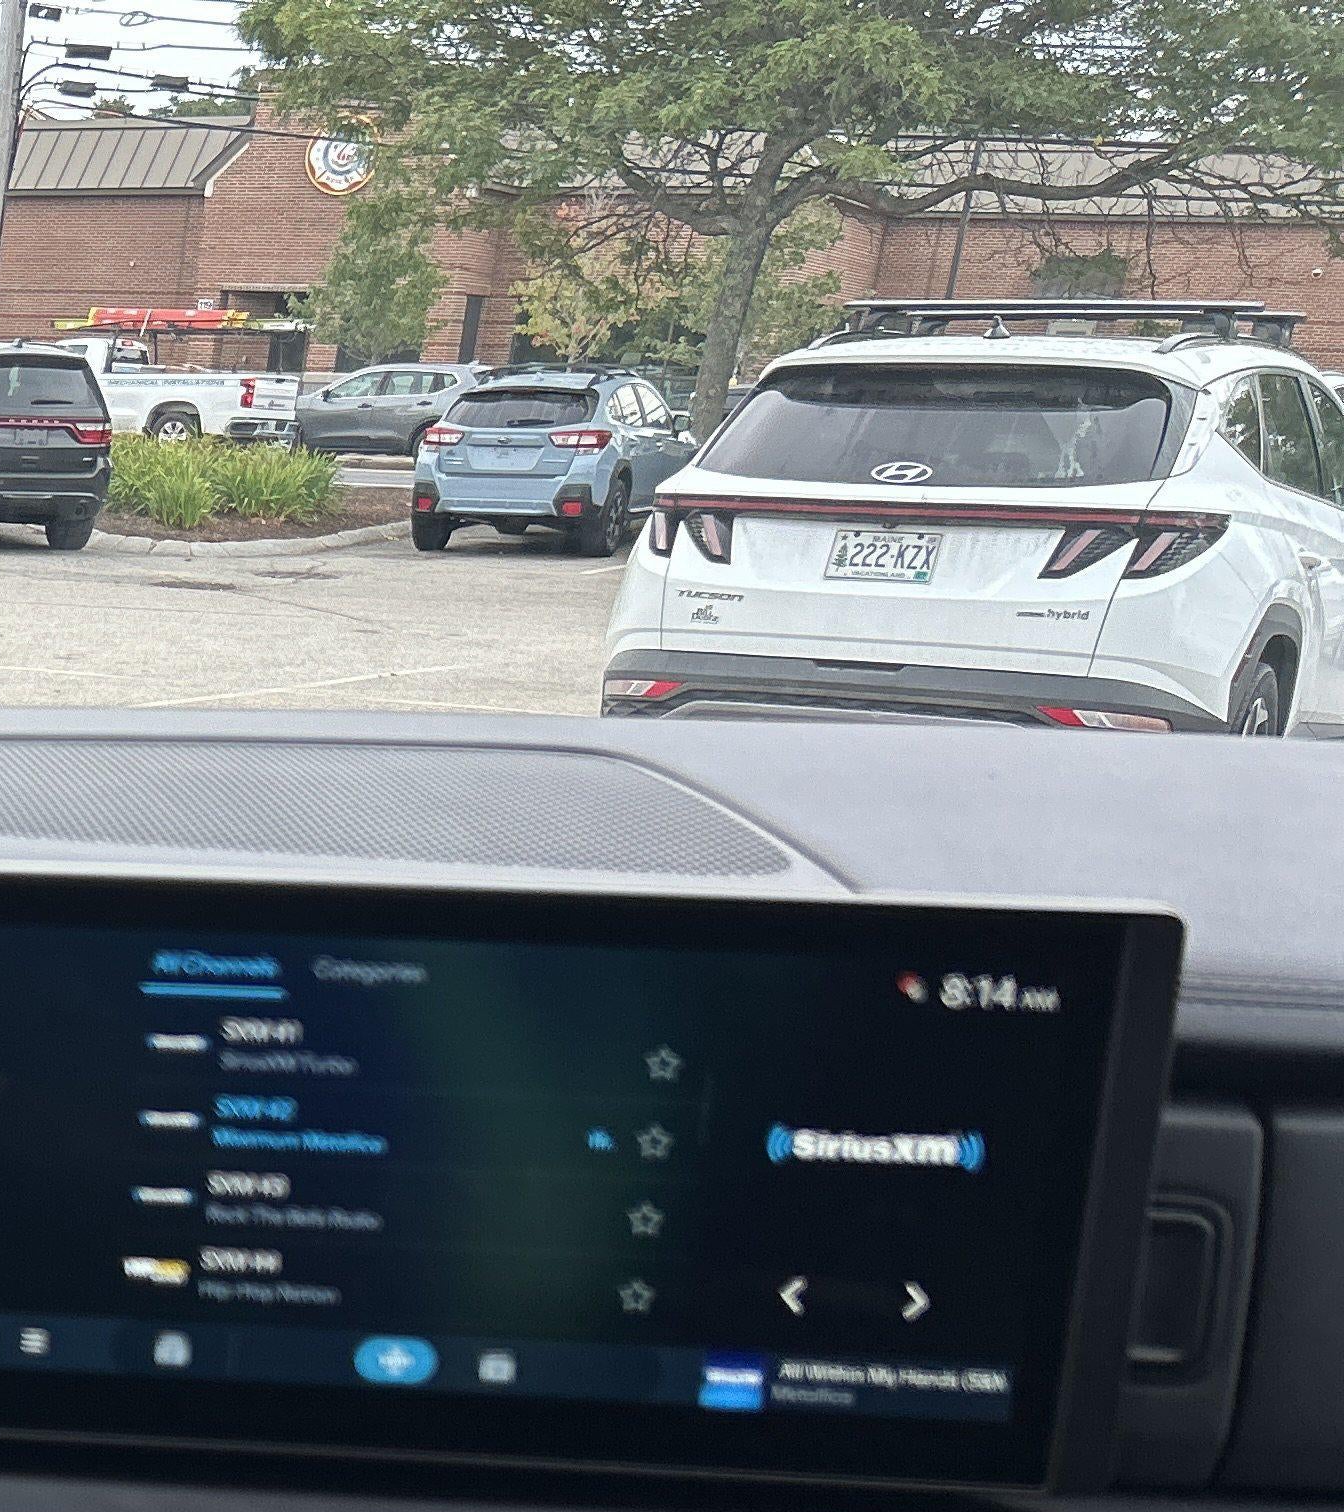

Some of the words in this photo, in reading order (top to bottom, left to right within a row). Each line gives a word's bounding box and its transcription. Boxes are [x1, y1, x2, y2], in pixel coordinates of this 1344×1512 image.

[848, 542, 937, 571] 222-KZX
[1046, 608, 1091, 621] hybrid
[940, 972, 1017, 1011] 8:14
